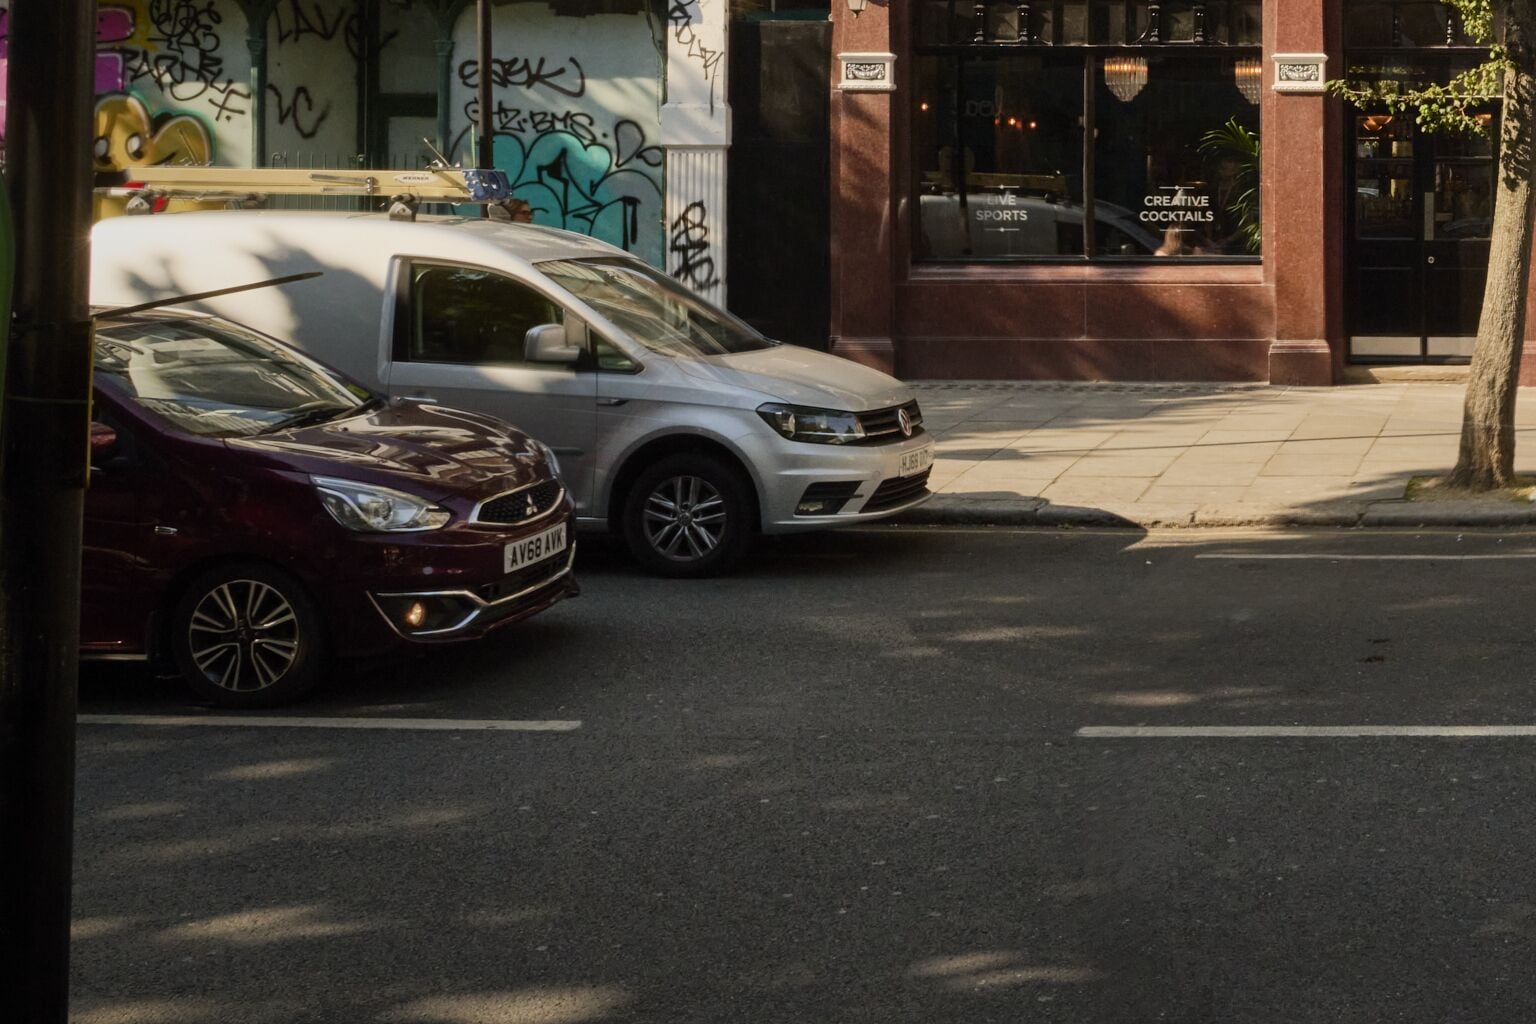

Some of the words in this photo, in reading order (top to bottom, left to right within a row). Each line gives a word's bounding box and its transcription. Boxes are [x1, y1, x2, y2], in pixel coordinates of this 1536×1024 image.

[988, 194, 1017, 206] LIVE
[1143, 195, 1210, 207] CREATIVE
[975, 210, 1028, 222] SPORTS
[1138, 210, 1214, 222] COCKTAILS
[510, 537, 542, 569] AV68
[544, 527, 563, 555] AVK
